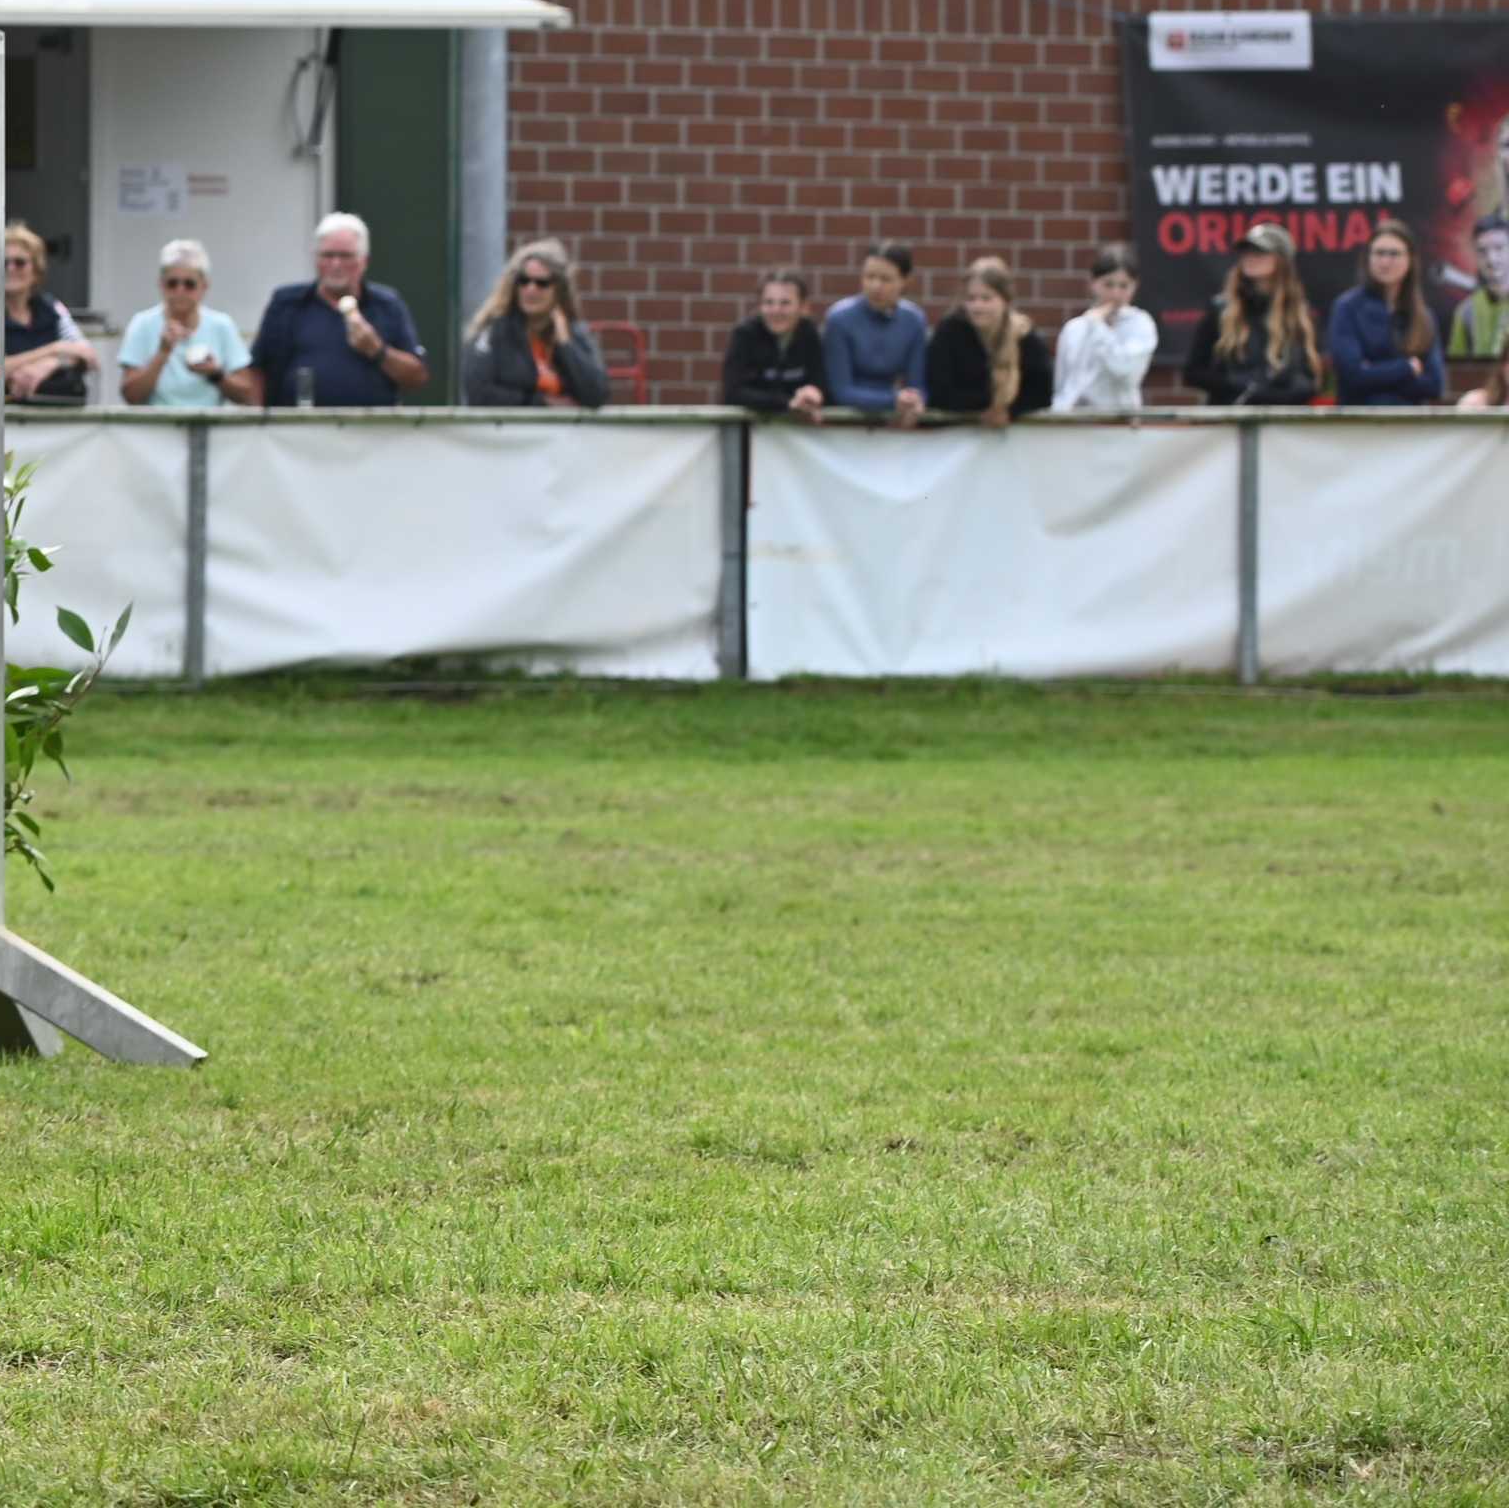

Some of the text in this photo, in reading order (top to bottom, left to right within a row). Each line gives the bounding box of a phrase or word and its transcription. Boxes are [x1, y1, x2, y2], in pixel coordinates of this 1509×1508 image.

[1152, 161, 1403, 206] WERDE EIN
[1157, 208, 1393, 255] ORIINA
